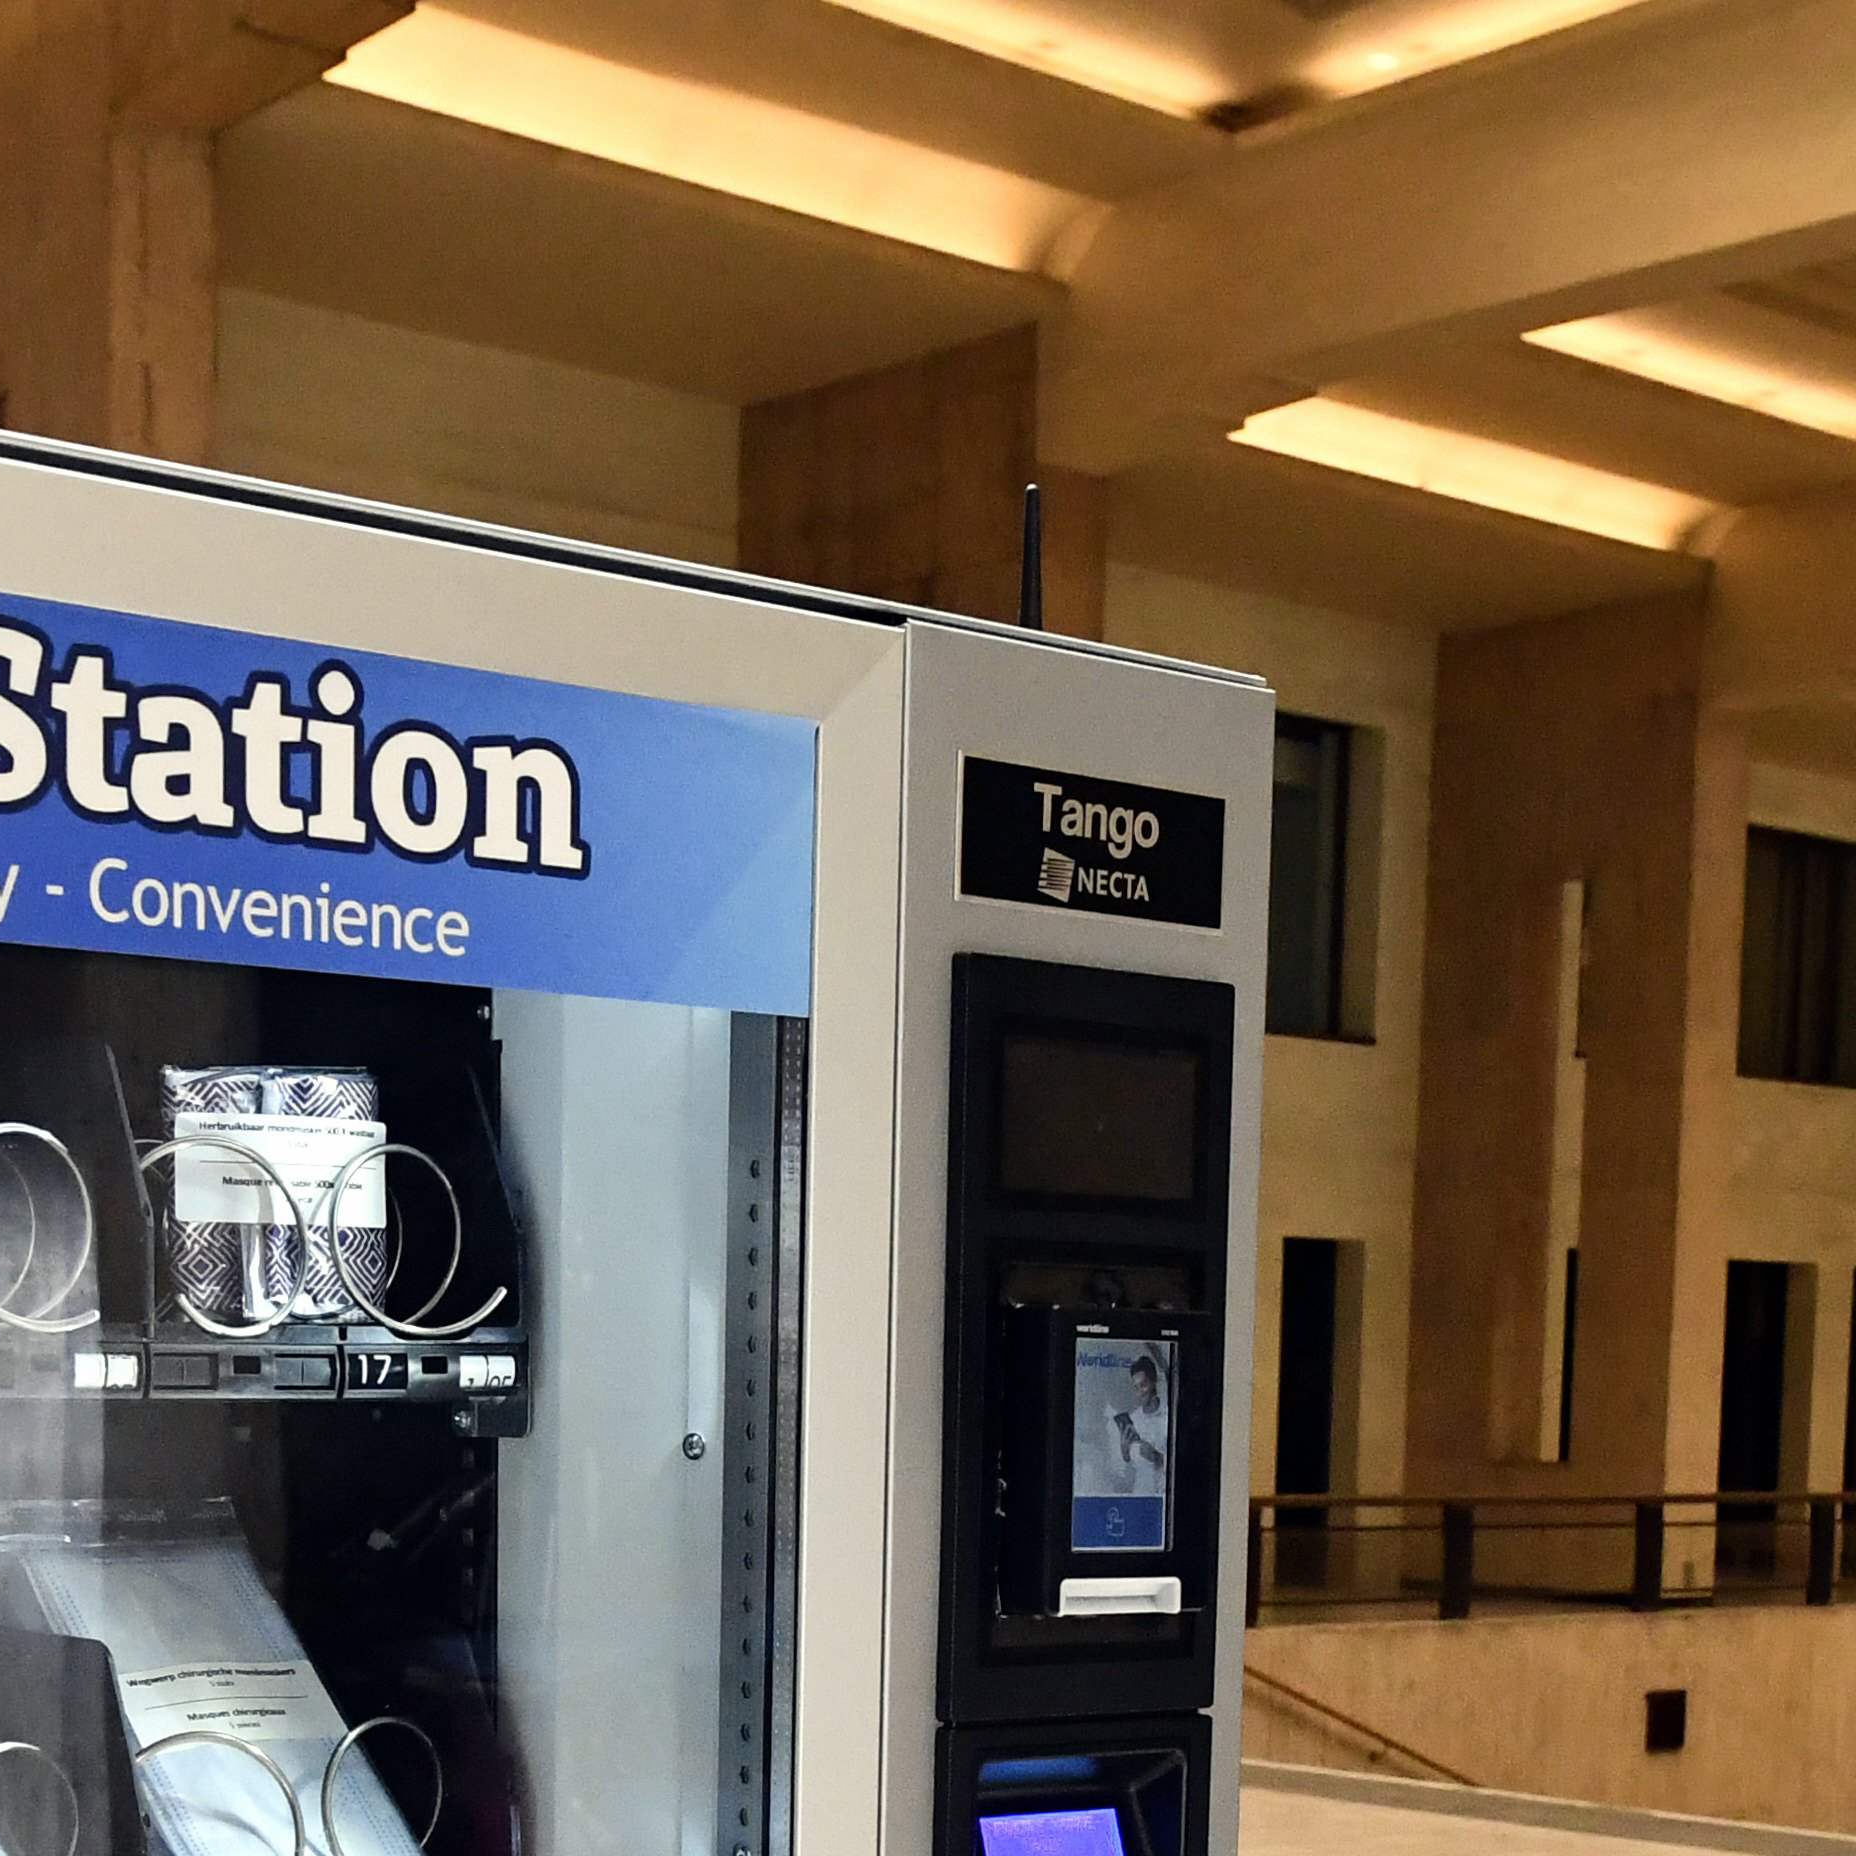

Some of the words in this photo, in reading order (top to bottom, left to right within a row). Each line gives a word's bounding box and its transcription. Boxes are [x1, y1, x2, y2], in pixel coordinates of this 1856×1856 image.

[1033, 782, 1160, 859] Tango
[1077, 867, 1150, 902] NECTA
[90, 859, 471, 958] Convenience
[199, 1121, 264, 1132] Herbruikbaar
[222, 1176, 263, 1187] Masque
[357, 1353, 392, 1385] 17
